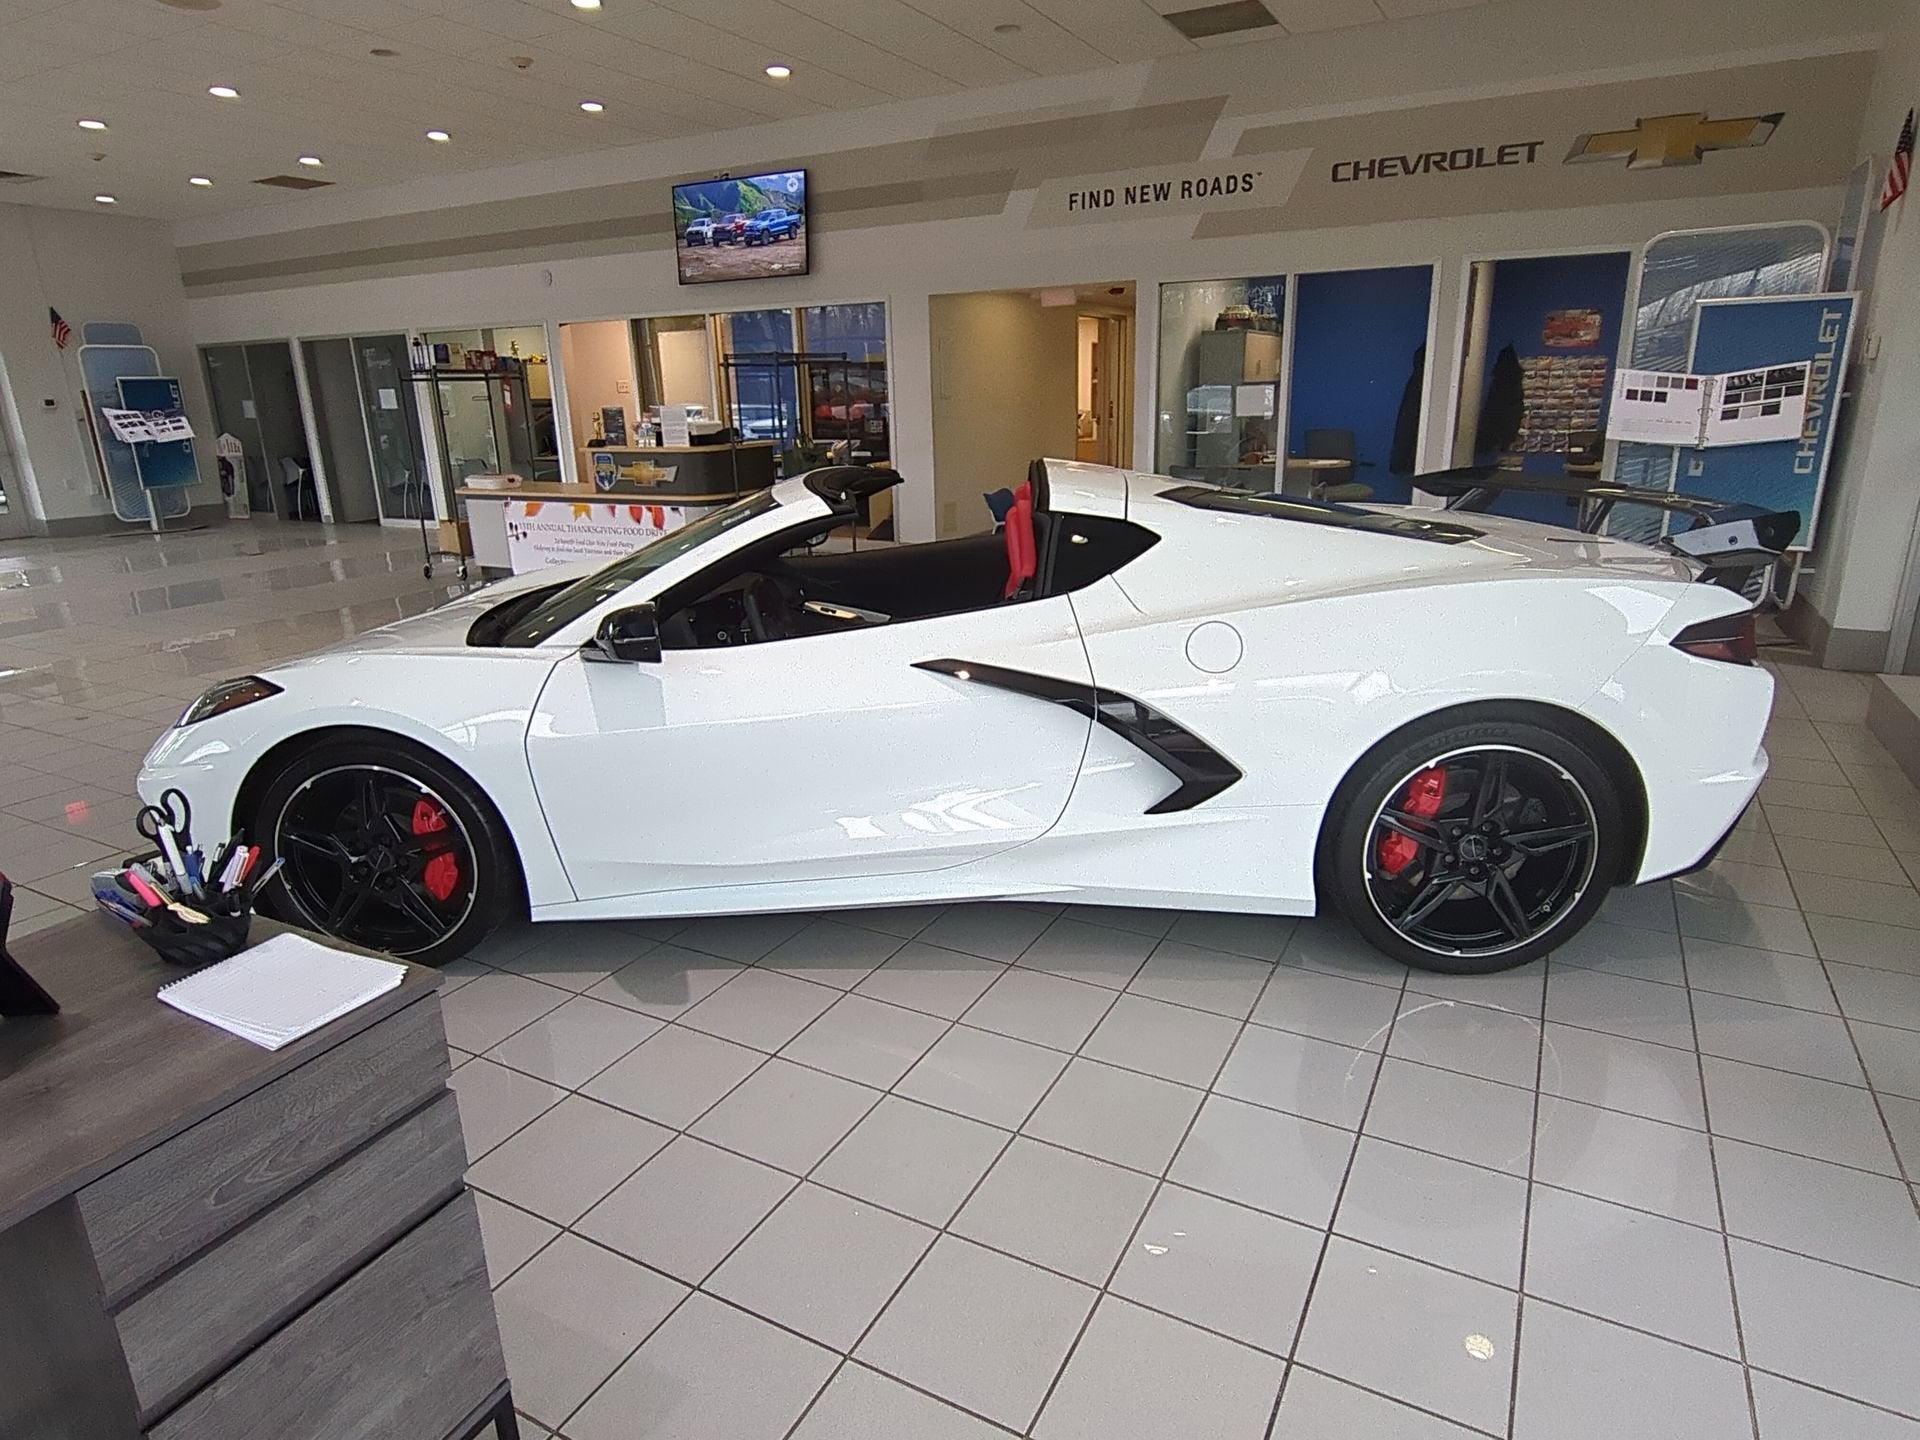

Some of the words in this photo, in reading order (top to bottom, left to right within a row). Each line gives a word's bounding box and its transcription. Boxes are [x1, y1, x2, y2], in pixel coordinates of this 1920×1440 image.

[1331, 140, 1545, 183] CHEVROLET
[1068, 188, 1115, 211] FIND
[1124, 181, 1172, 206] NEW
[1793, 307, 1843, 474] CHEVROLET
[536, 522, 566, 533] ANNUAL
[567, 523, 623, 536] THANKSGIVING
[623, 526, 645, 537] FOOD
